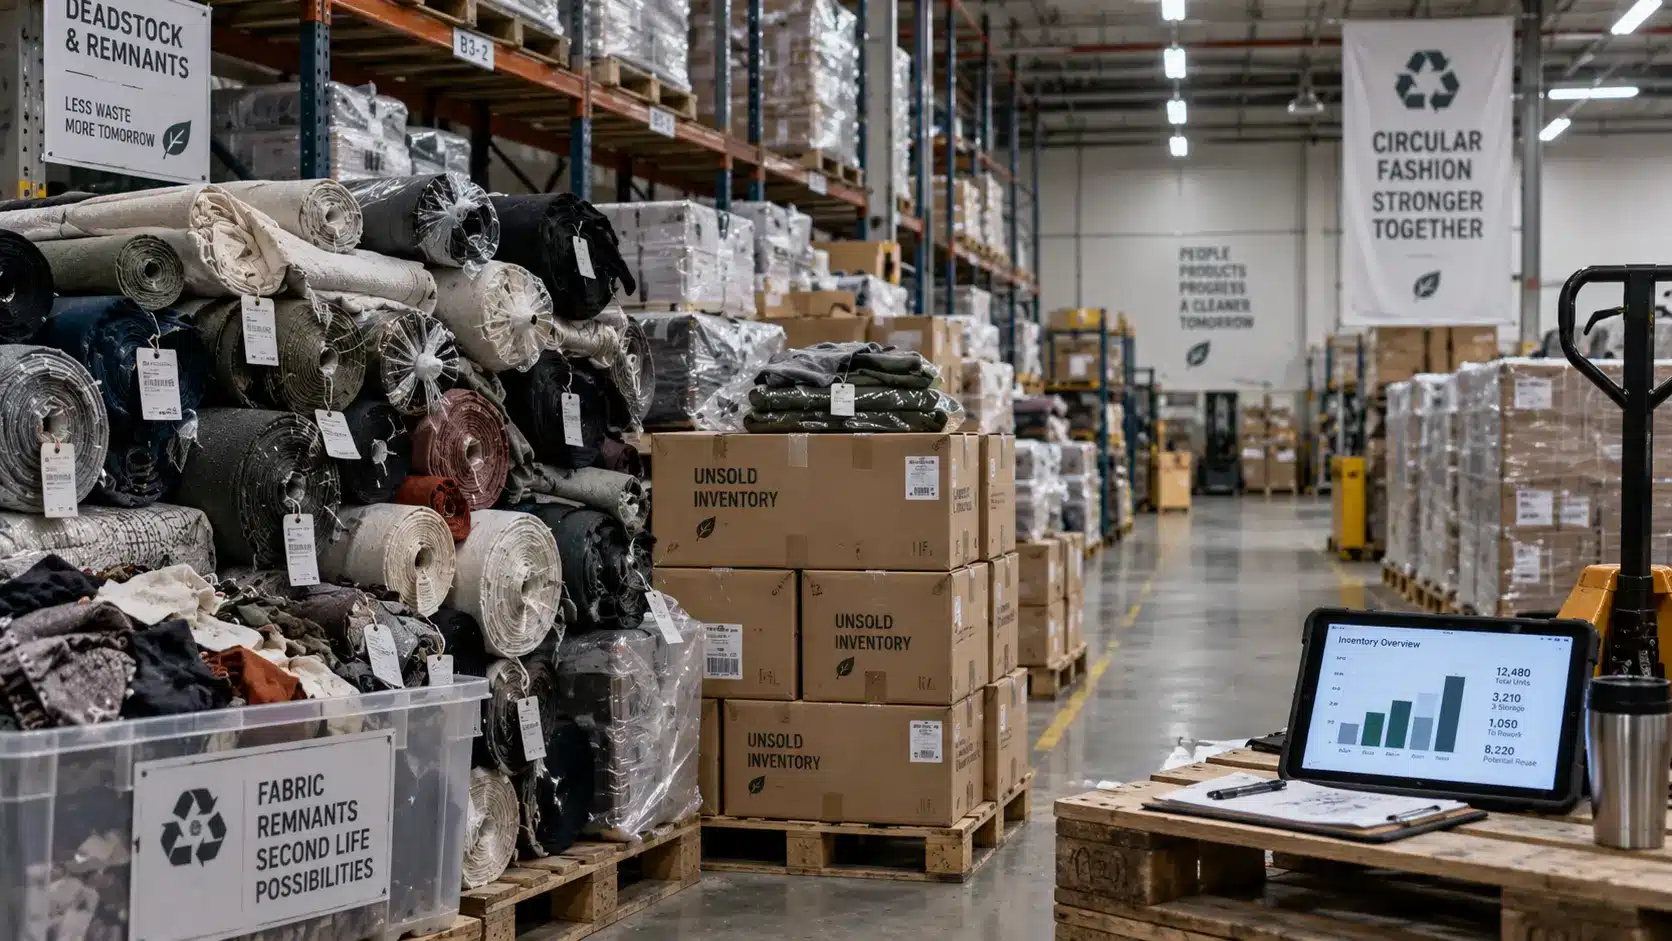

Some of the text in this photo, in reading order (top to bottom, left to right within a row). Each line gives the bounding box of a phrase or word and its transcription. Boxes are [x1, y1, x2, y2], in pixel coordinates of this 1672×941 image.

[65, 0, 183, 48] DEADSTOCK
[65, 28, 189, 79] & REMNANTS
[460, 34, 488, 61] B3-2
[65, 95, 131, 123] LESS WASTE
[65, 118, 155, 147] MORE TOMORROW
[1372, 130, 1483, 153] CIRCULAR
[1377, 158, 1472, 181] FASHION
[1372, 190, 1483, 212] STRONGER
[1371, 218, 1483, 240] TOGETHER
[1179, 264, 1247, 278] PRODUCTS
[1179, 281, 1246, 296] PROGRESS
[1180, 299, 1189, 312] A
[1180, 316, 1255, 330] TOMORROW
[693, 467, 758, 484] UNSOLD
[693, 490, 779, 508] INVENTORY
[835, 613, 894, 629] UNSOLD
[835, 634, 912, 651] INVENTORY
[1380, 638, 1421, 649] Overview
[747, 732, 804, 749] UNSOLD
[747, 753, 821, 770] INVENTORY
[258, 773, 324, 806] FABRIC
[257, 800, 358, 839] REMNANTS
[256, 828, 370, 871] SECOND LIFE
[256, 857, 374, 904] POSSIBILITIES
